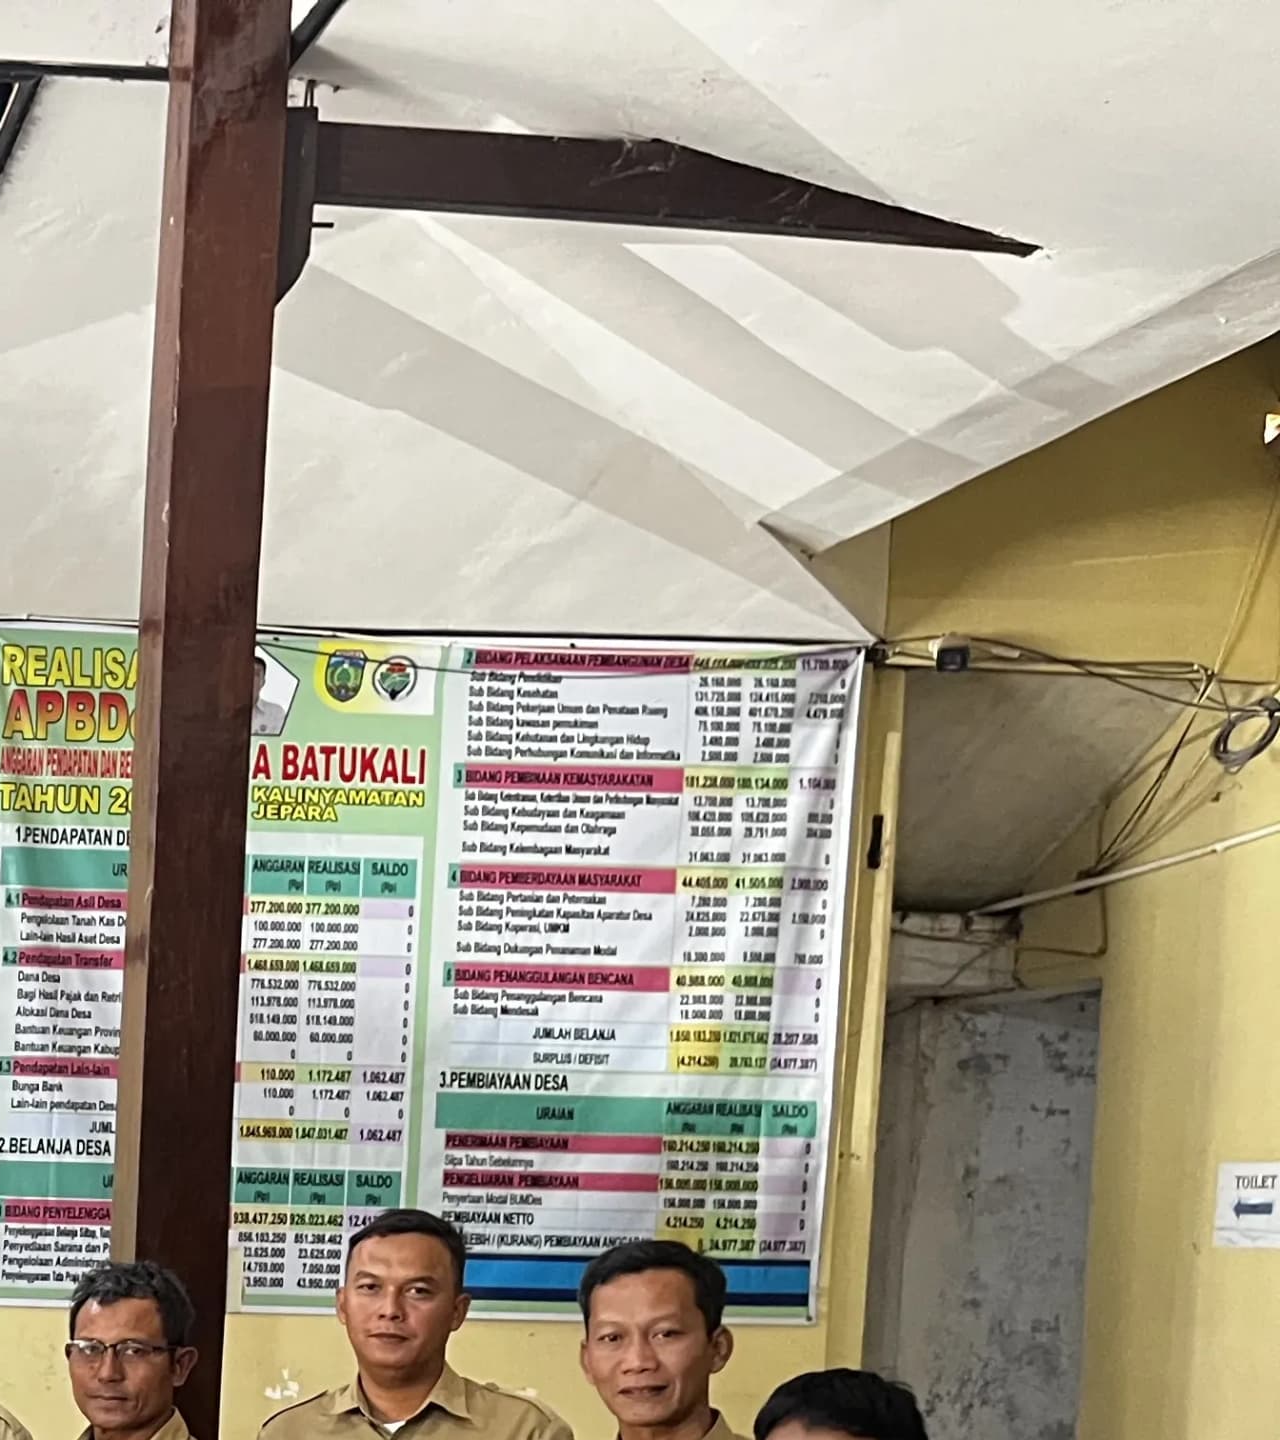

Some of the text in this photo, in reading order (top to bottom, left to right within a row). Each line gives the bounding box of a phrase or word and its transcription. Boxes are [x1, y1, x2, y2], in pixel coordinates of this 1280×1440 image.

[0, 746, 43, 776] ANGGARAN
[47, 747, 99, 778] PENDAPATAN
[282, 744, 426, 785] BATUKALI
[563, 771, 653, 786] KEMASYARAKATAN
[109, 786, 132, 815] 2
[252, 786, 425, 807] KALINYAMATAN
[252, 804, 338, 822] JEPARA
[252, 859, 408, 876] ANGGARAN REALISASI SALDO
[579, 872, 642, 887] MASYARAKAT
[22, 893, 121, 908] Pendapatan Desa
[251, 901, 359, 916] 377.200.000 377.200.000
[72, 914, 115, 926] Tanah Kas
[254, 920, 358, 934] 100.000.000 100.000.000
[56, 932, 76, 943] Hasil
[99, 934, 120, 944] Desa
[19, 952, 113, 967] Pendapatan Transfer
[18, 971, 60, 983] Dana Desa
[455, 969, 634, 986] BIDANG PENANGGULANGAN BENCANA
[60, 990, 81, 1003] Pajak
[84, 992, 99, 1002] dan
[72, 1008, 92, 1019] Desa
[15, 1023, 92, 1039] Bantuan Keuangan
[533, 1028, 616, 1041] JUMLAH BELANJA
[14, 1041, 49, 1052] Bantuan
[52, 1042, 91, 1056] Keuangan
[13, 1061, 110, 1076] Pendapatan Lain-lain
[261, 1068, 405, 1084] 110.000 1.172.487 1.062.487
[12, 1080, 63, 1094] Bunga Bank
[534, 1074, 568, 1091] DESA
[264, 1088, 404, 1102] 110.000 1.172.487 1.062.487
[11, 1098, 97, 1112] Lain-lain pendapatan
[772, 1104, 808, 1118] SALDO
[536, 1106, 574, 1120] URAIAN
[360, 1129, 402, 1142] 1.062.487
[76, 1140, 111, 1156] DESA
[237, 1172, 392, 1188] ANGGARAN REALISASI SALDO
[1235, 1175, 1277, 1190] TOILET
[5, 1205, 40, 1217] BIDANG
[503, 1212, 534, 1225] NETTO
[234, 1212, 344, 1227] 938.437.250 926.023.462
[54, 1241, 83, 1252] Sarana
[85, 1242, 100, 1253] dan
[497, 1234, 542, 1249] (KURANG)
[544, 1235, 600, 1248] PEMBIAYAAN
